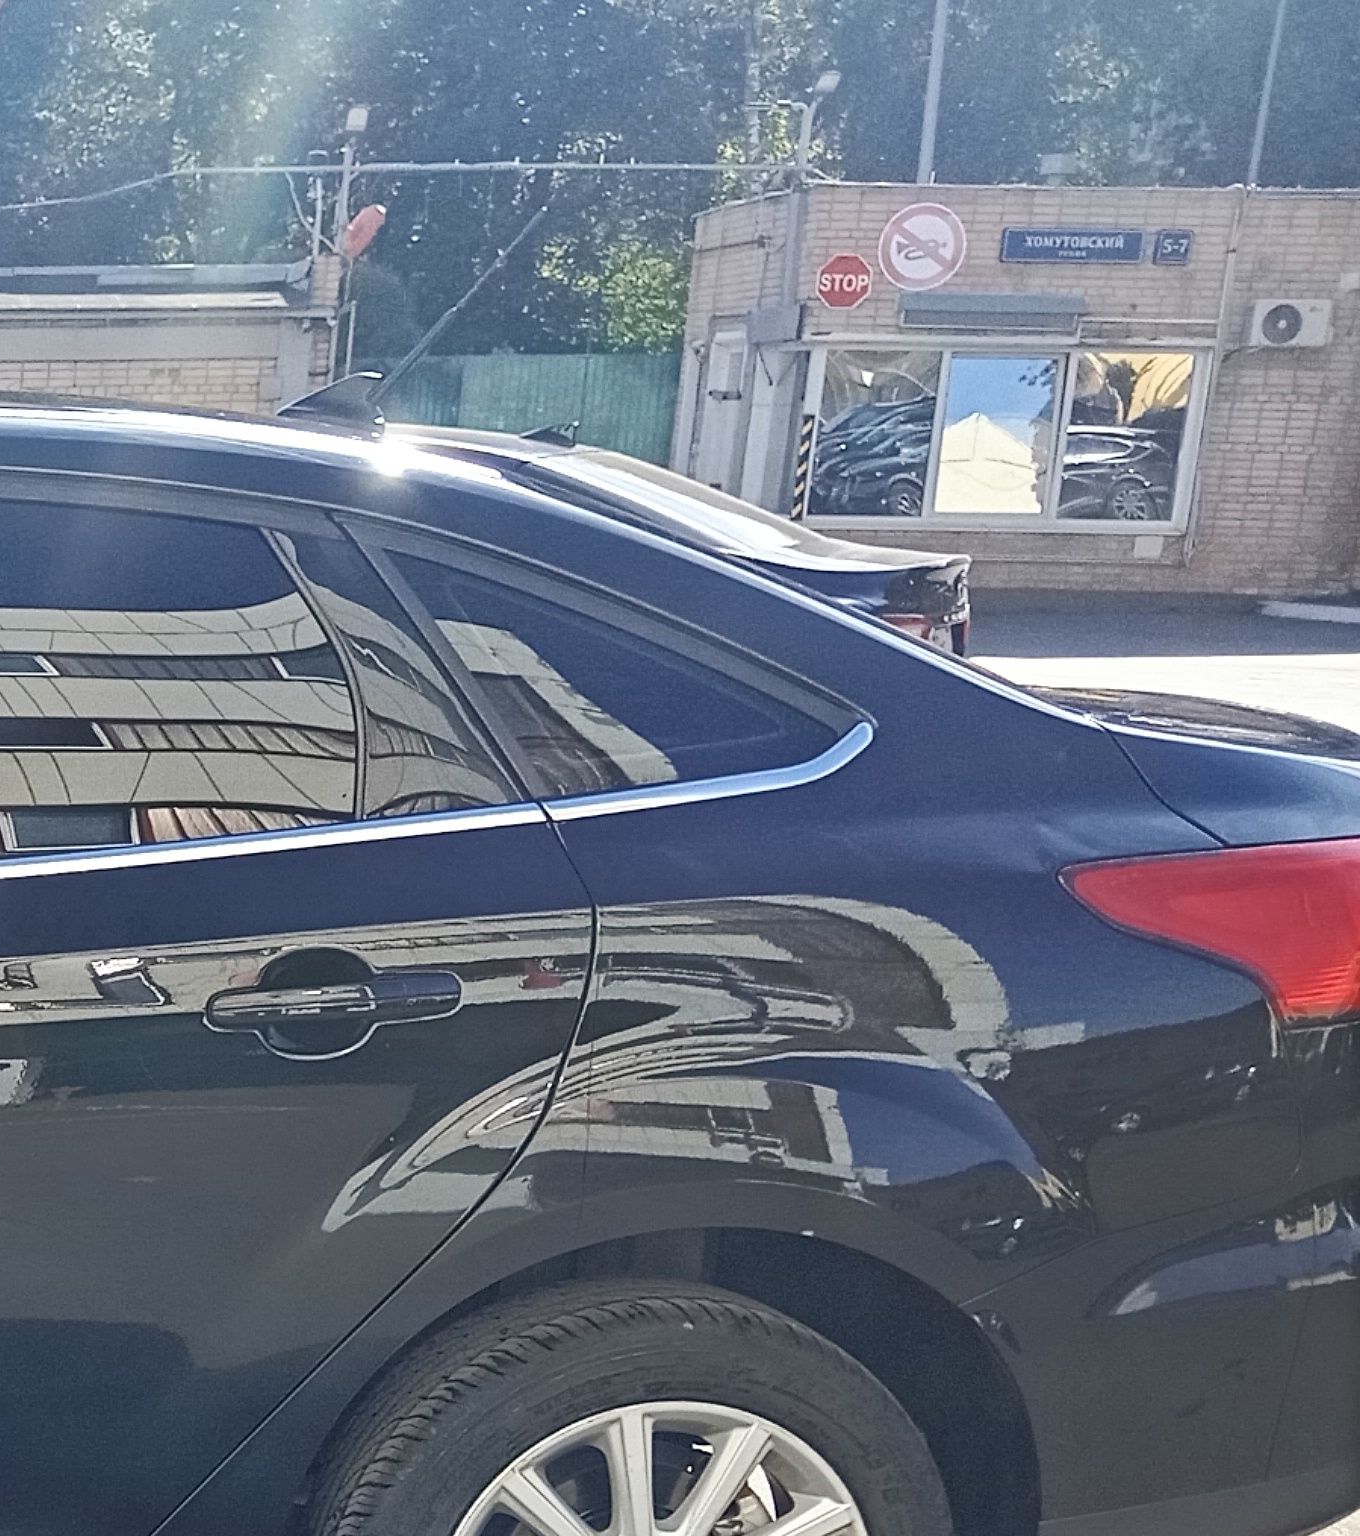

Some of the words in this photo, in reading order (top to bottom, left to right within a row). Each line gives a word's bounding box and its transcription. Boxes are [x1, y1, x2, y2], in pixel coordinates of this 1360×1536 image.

[1023, 234, 1125, 249] ХОМУТОВСКИЙ
[1161, 239, 1190, 254] 5-7
[819, 273, 869, 293] STOP
